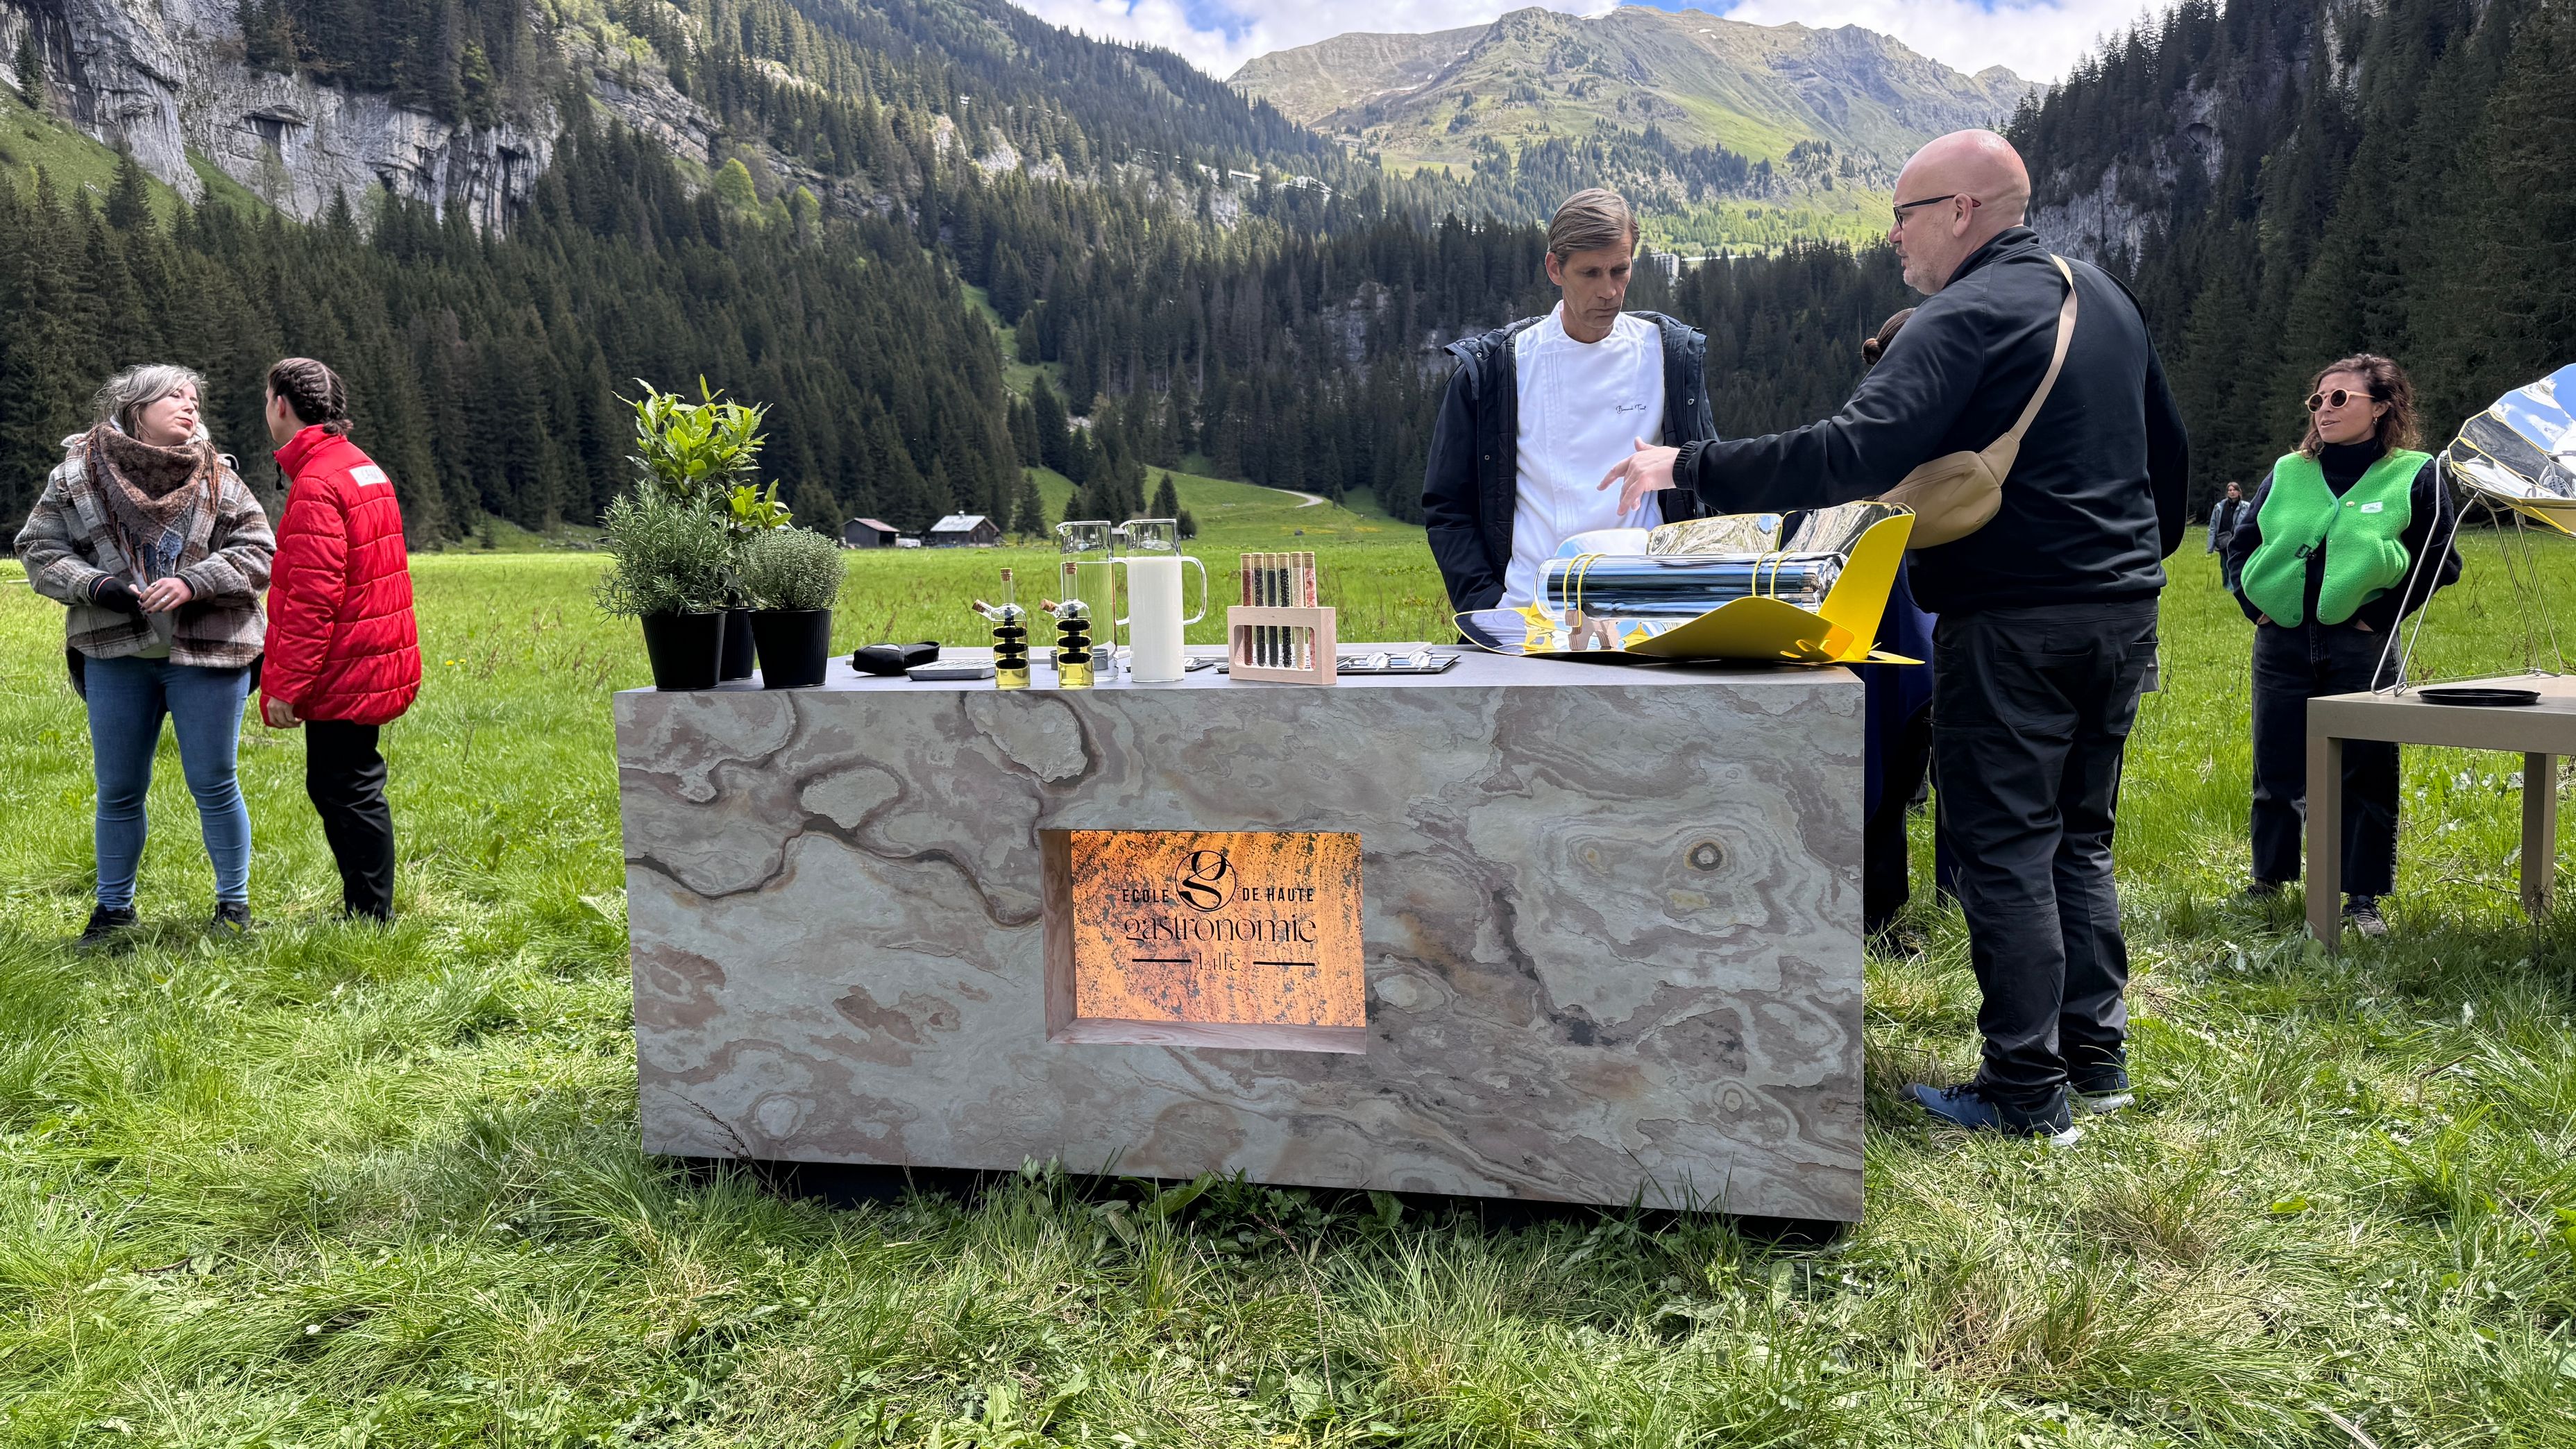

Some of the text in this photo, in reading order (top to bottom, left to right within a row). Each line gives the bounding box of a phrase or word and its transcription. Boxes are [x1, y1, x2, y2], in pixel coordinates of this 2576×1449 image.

[1123, 888, 1314, 903] ECOLE DE HAUTE
[1124, 914, 1316, 944] gastronomie
[1198, 952, 1241, 971] Lille
